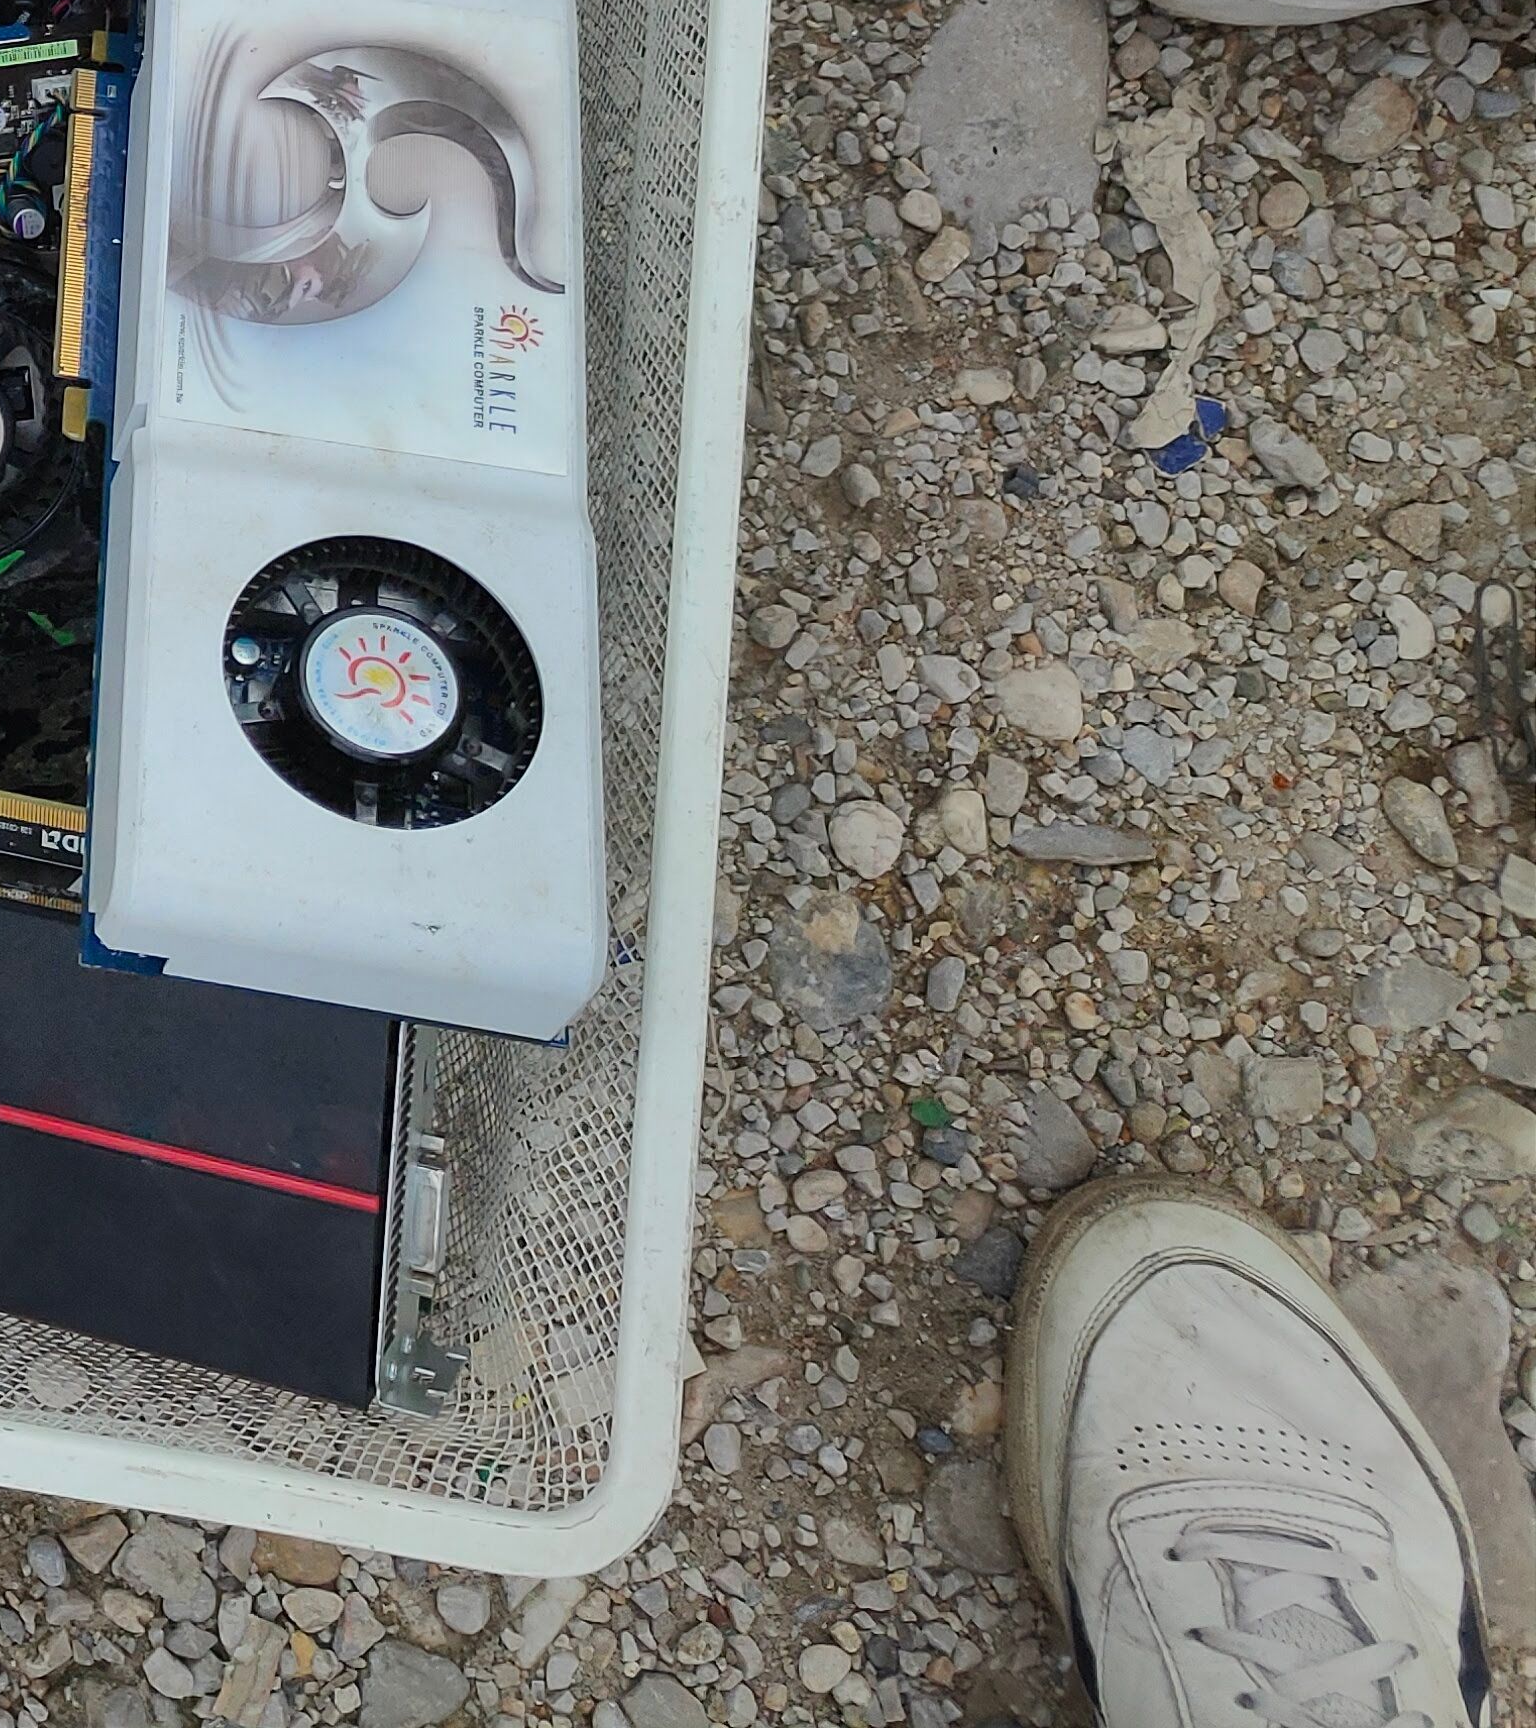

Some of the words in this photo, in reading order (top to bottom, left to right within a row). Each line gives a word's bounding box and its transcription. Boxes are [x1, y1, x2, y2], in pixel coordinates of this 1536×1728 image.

[472, 306, 484, 358] SPARKLE
[472, 361, 484, 429] COMPUTER
[485, 324, 517, 436] SPARKLE
[372, 621, 419, 645] SPARKLE
[420, 644, 449, 698] COMPUTER
